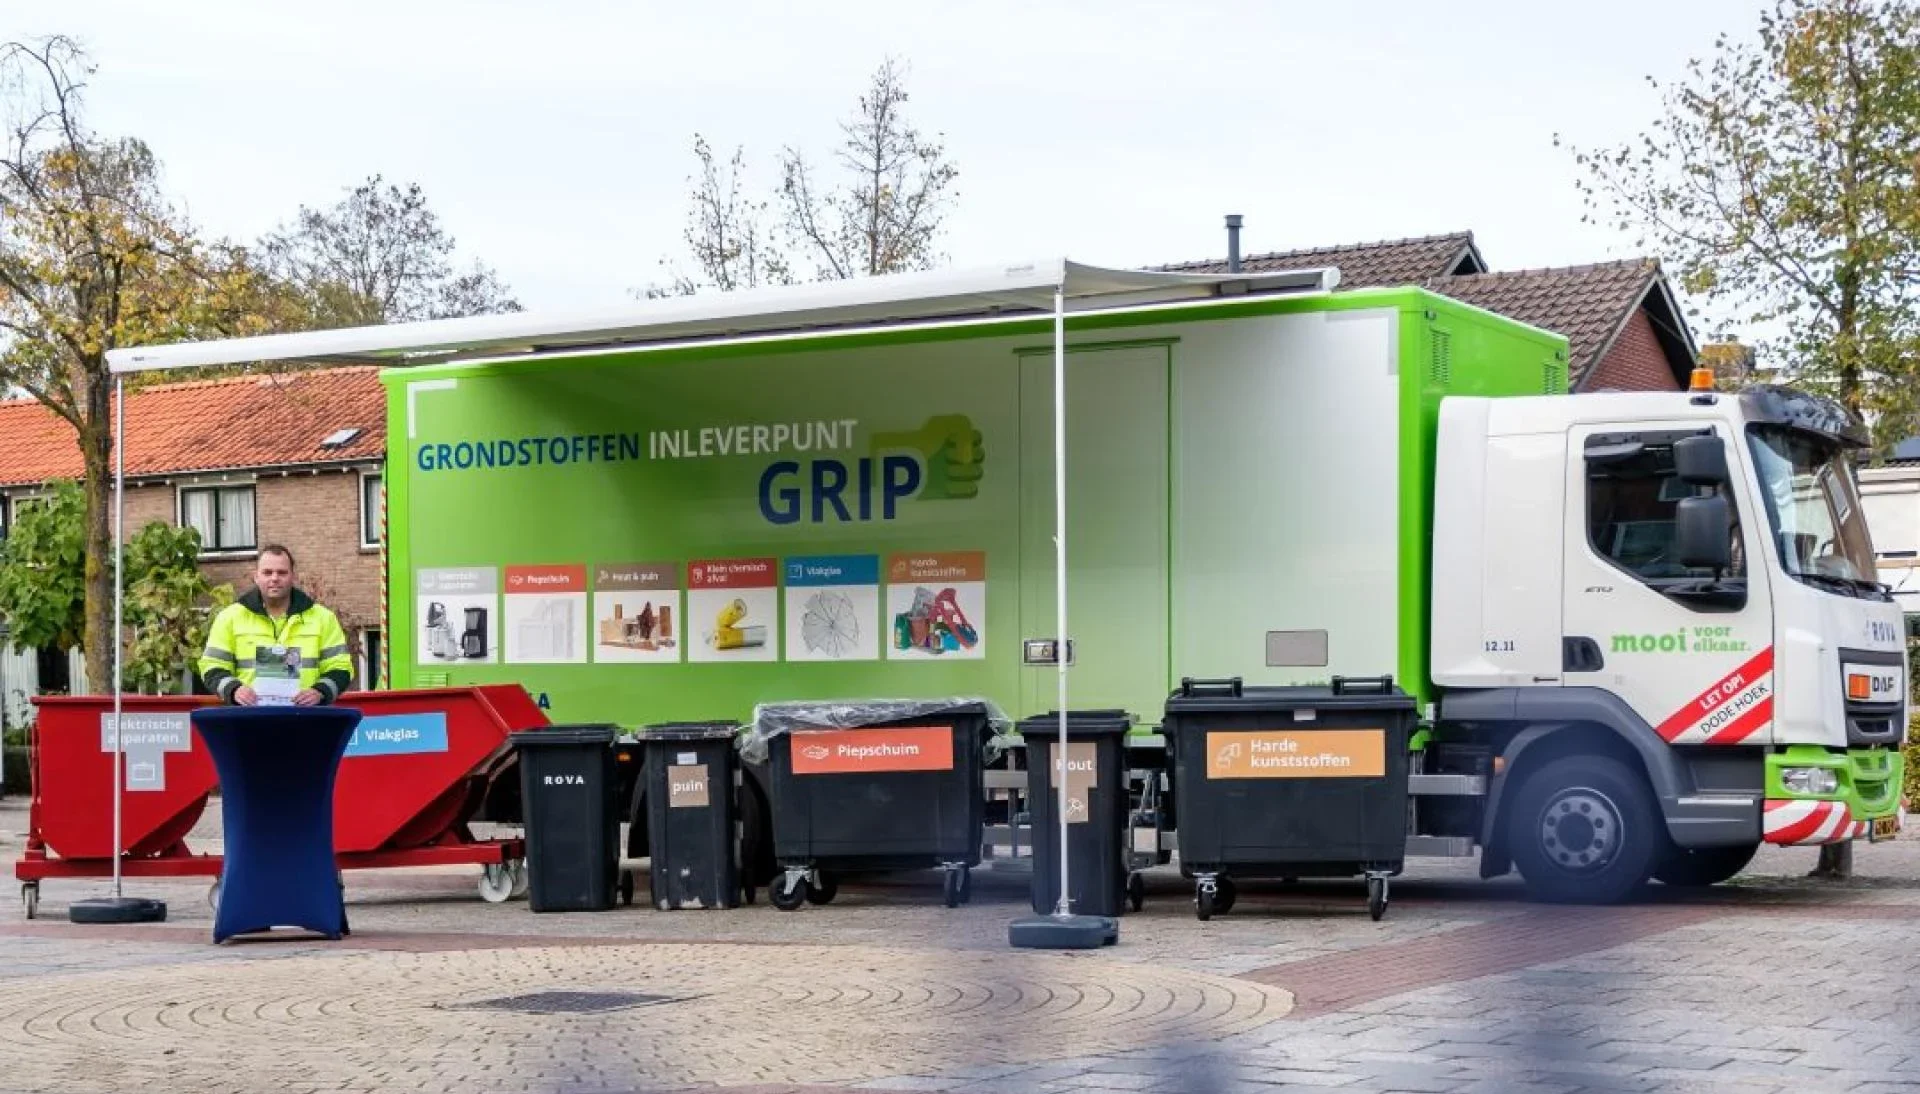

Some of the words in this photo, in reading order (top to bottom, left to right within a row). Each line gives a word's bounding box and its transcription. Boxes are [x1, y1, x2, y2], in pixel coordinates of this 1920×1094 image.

[417, 432, 640, 471] GRONDSTOFFEN
[650, 419, 858, 460] INLEVERPUNT
[758, 456, 921, 525] GRIP
[1692, 626, 1732, 637] voor
[1485, 640, 1515, 652] 12.11
[1611, 627, 1687, 652] mooi
[1872, 676, 1894, 692] DAF
[1700, 689, 1721, 710] LET
[1701, 705, 1735, 734] DODE
[1735, 683, 1769, 711] HOEK
[107, 718, 183, 730] Eektrische
[107, 732, 179, 745] aparaten
[365, 728, 420, 742] Vlakglas
[838, 744, 920, 760] Piepschuim
[1250, 739, 1297, 752] Harde
[1250, 753, 1351, 768] kunststoffen
[543, 775, 585, 785] ROVA
[672, 779, 704, 794] puin
